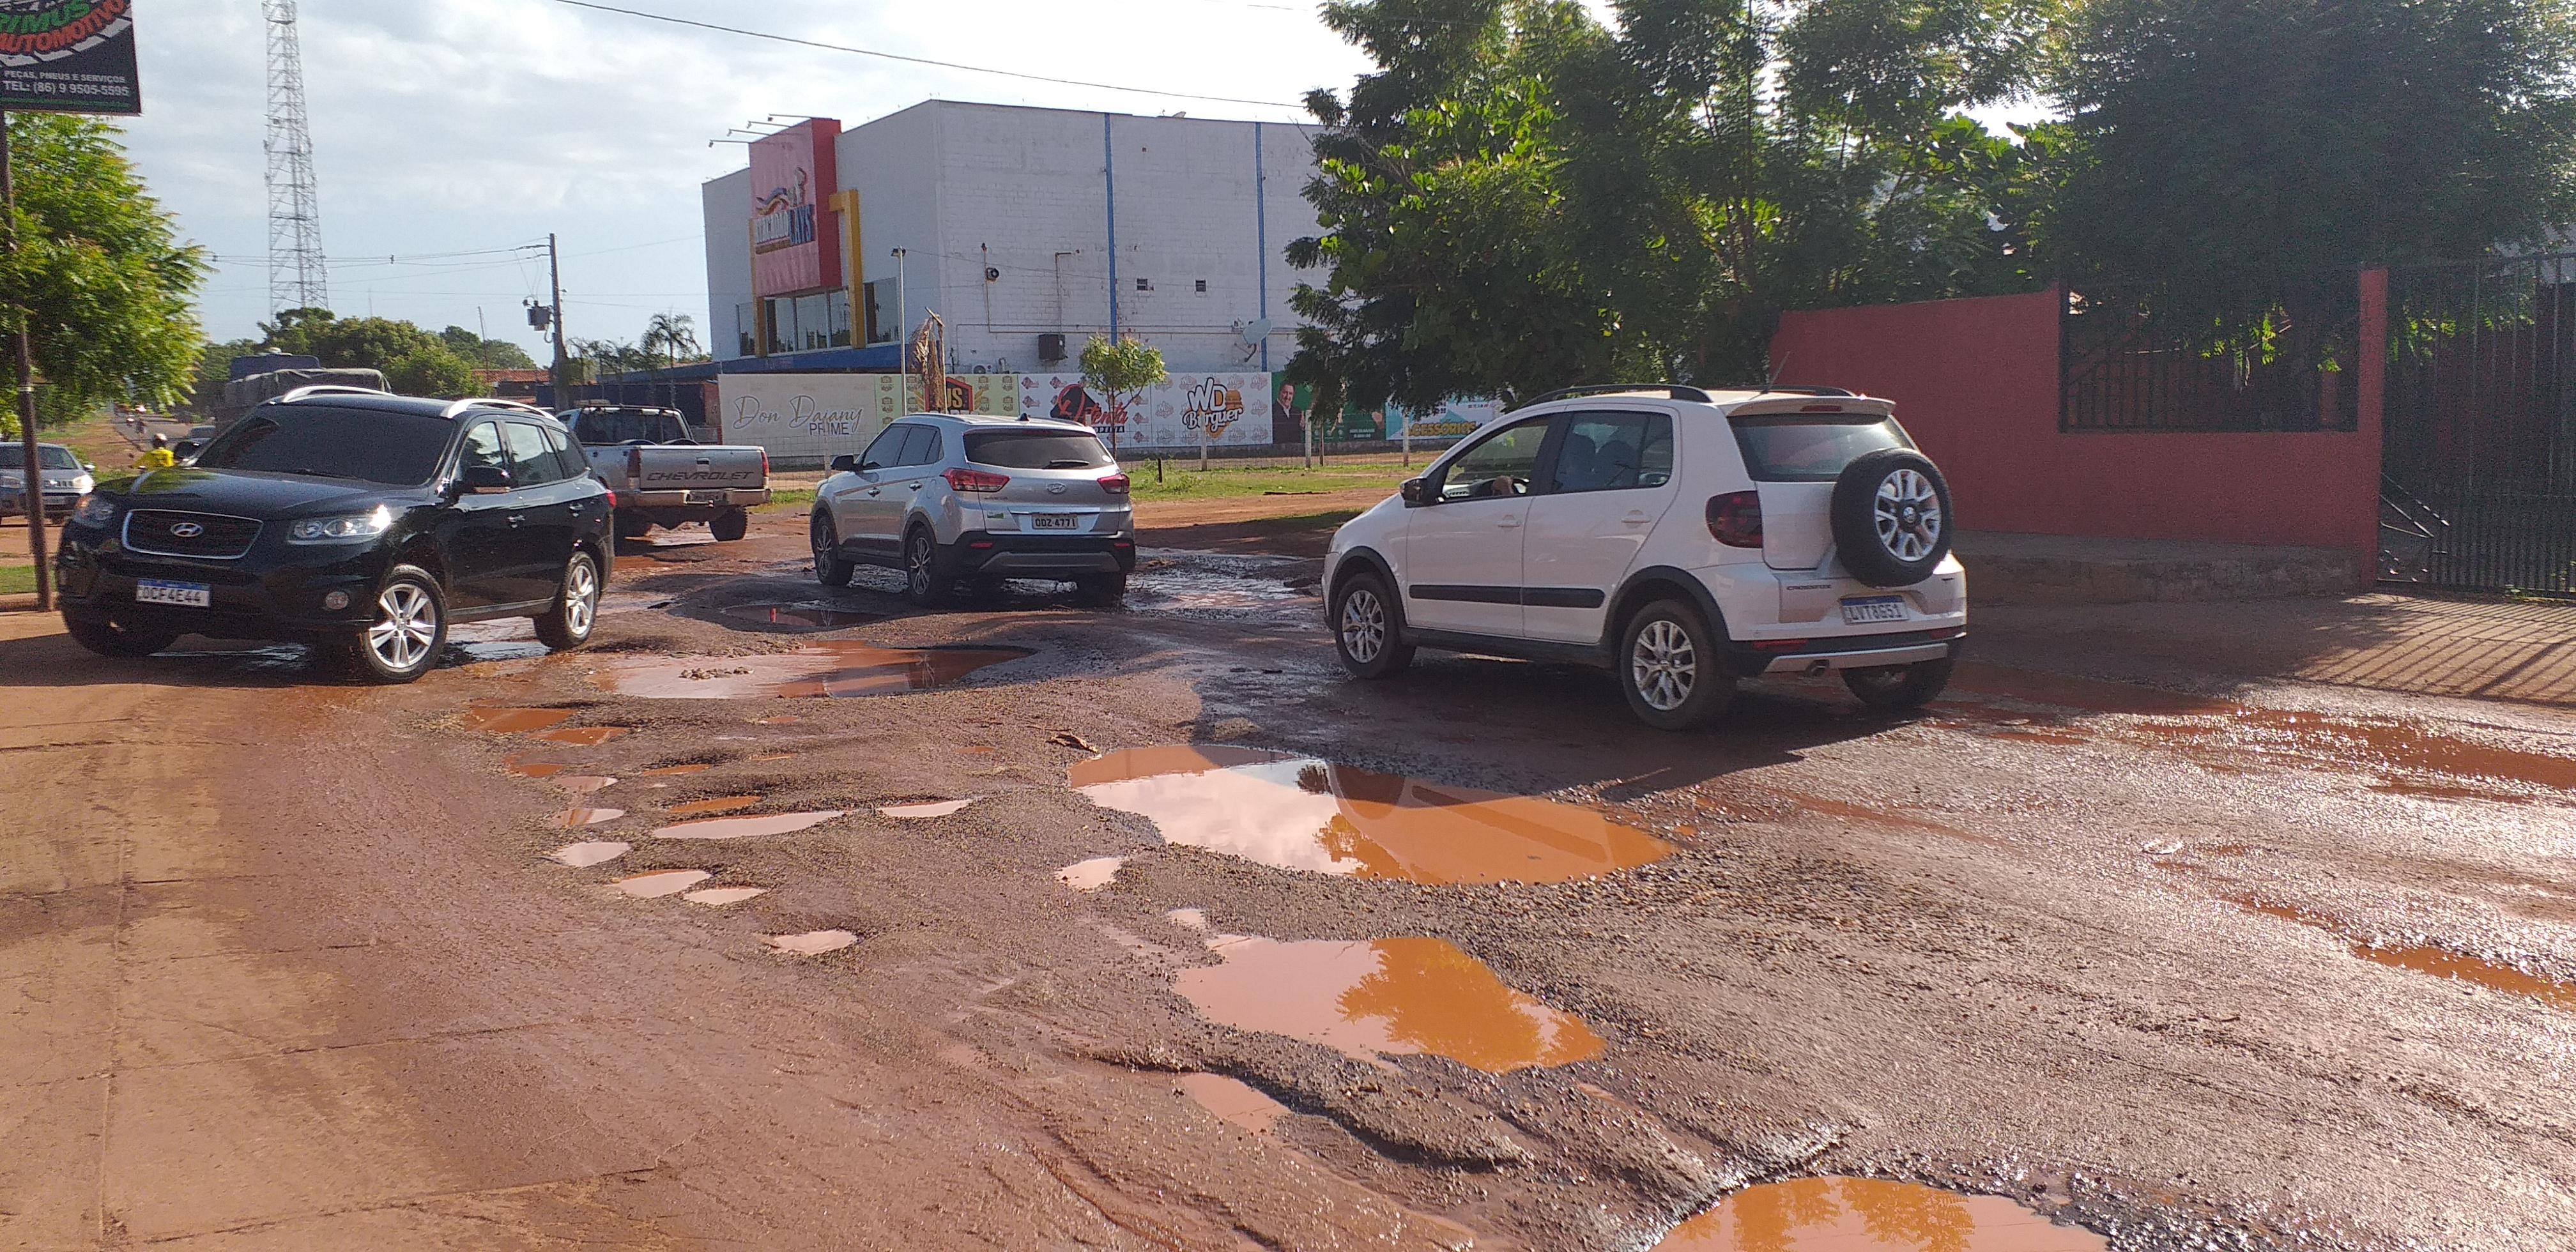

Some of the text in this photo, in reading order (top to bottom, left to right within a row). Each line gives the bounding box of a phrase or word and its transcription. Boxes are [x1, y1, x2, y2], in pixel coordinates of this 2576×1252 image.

[40, 72, 70, 80] PNEUS
[3, 80, 30, 91] TEL:
[33, 82, 56, 95] (86)
[59, 83, 66, 93] 9
[1187, 377, 1228, 412] WD
[733, 395, 862, 432] Don Daiany
[809, 422, 850, 436] PRIME
[647, 471, 754, 481] CHEVROLET
